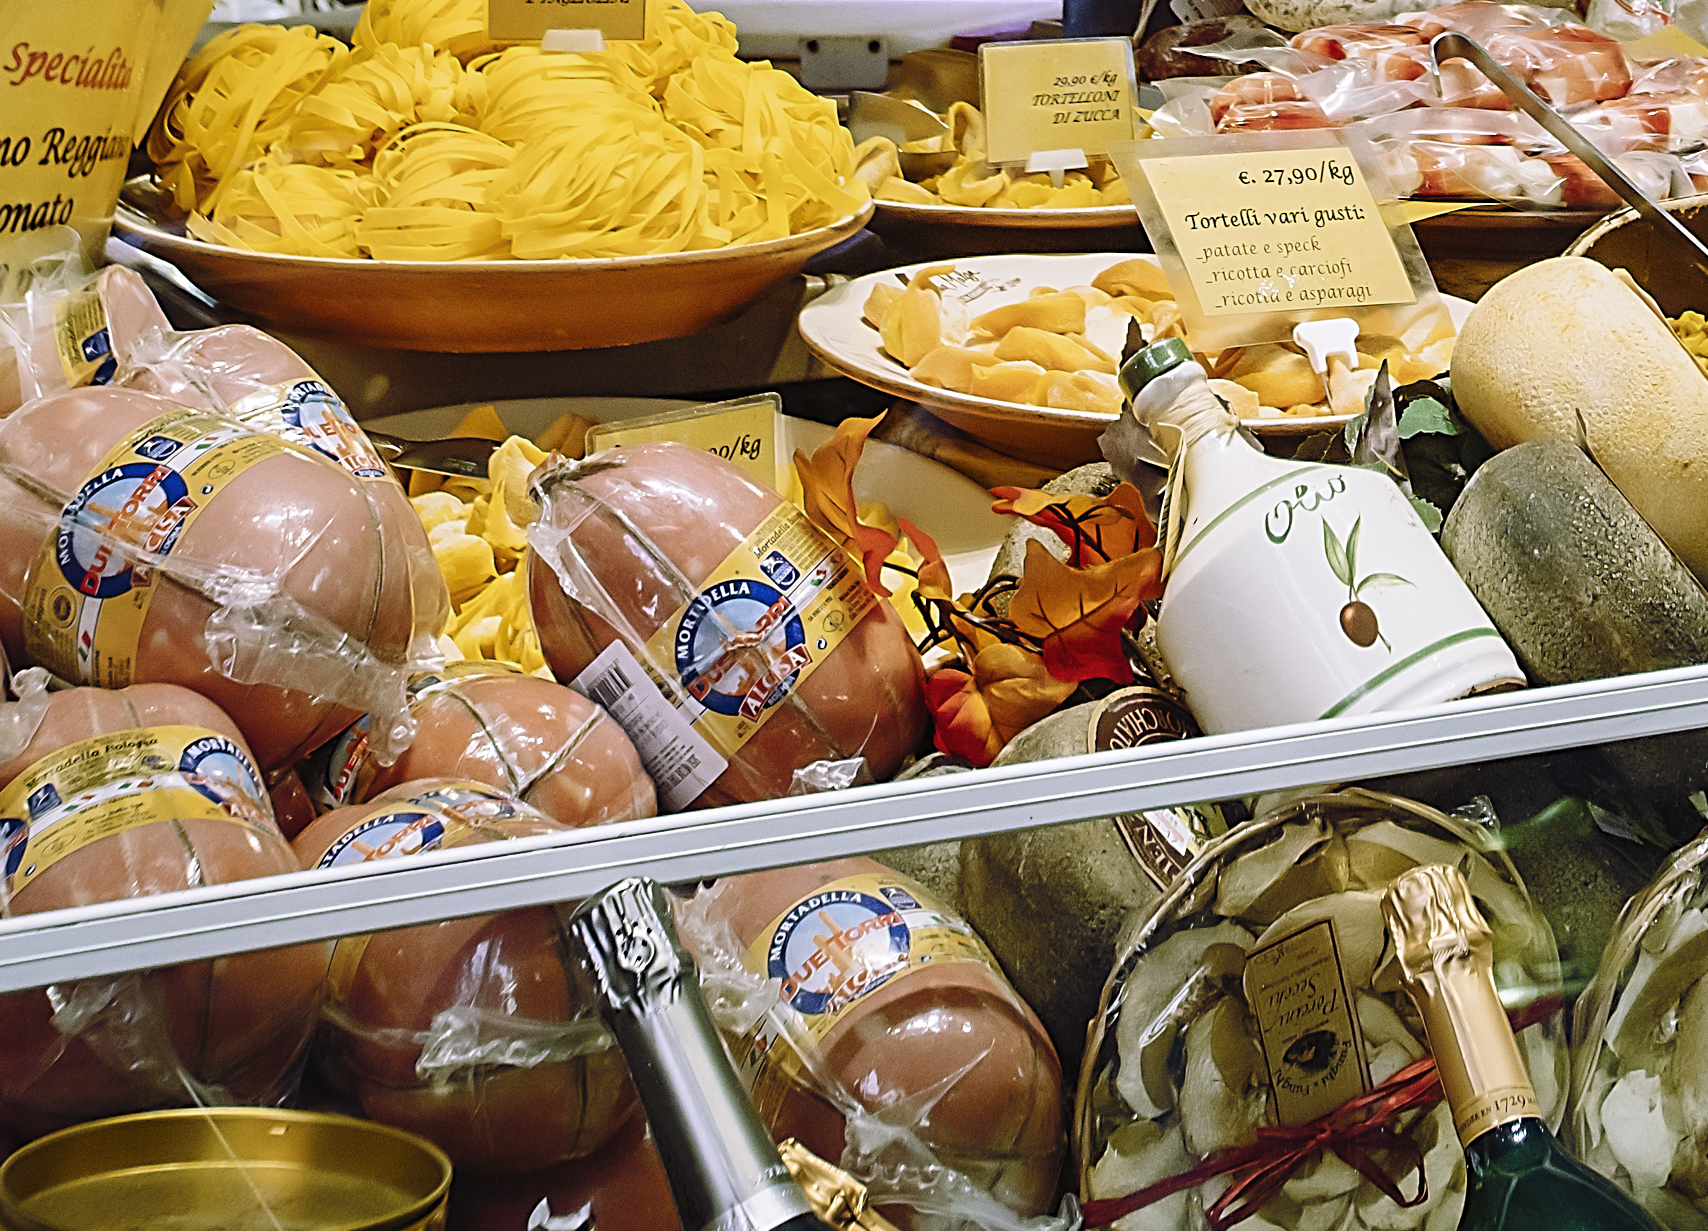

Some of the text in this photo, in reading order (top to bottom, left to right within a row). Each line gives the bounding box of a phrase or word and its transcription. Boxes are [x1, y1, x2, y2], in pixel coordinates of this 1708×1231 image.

[1090, 70, 1118, 88] €/kg
[1032, 90, 1121, 107] TORTELLONI
[1052, 109, 1121, 125] DI ZUCCA
[1263, 159, 1356, 186] 27,90/kg
[1185, 203, 1366, 230] Tortelli vari gusti:
[1263, 244, 1273, 255] e
[1277, 235, 1322, 259] speck
[1276, 265, 1285, 278] e
[1289, 257, 1354, 279] carciofi
[1285, 290, 1294, 302] e
[1299, 282, 1373, 306] asparagi
[710, 433, 762, 461] 0/kg
[108, 465, 175, 531] TORRI
[1265, 474, 1346, 544] Olio
[770, 891, 864, 962] MORTADELLA
[780, 910, 903, 1003] DUE TORRI
[1264, 973, 1321, 1015] Secchi
[1263, 989, 1339, 1034] Porcini
[1494, 1095, 1527, 1113] 1729
